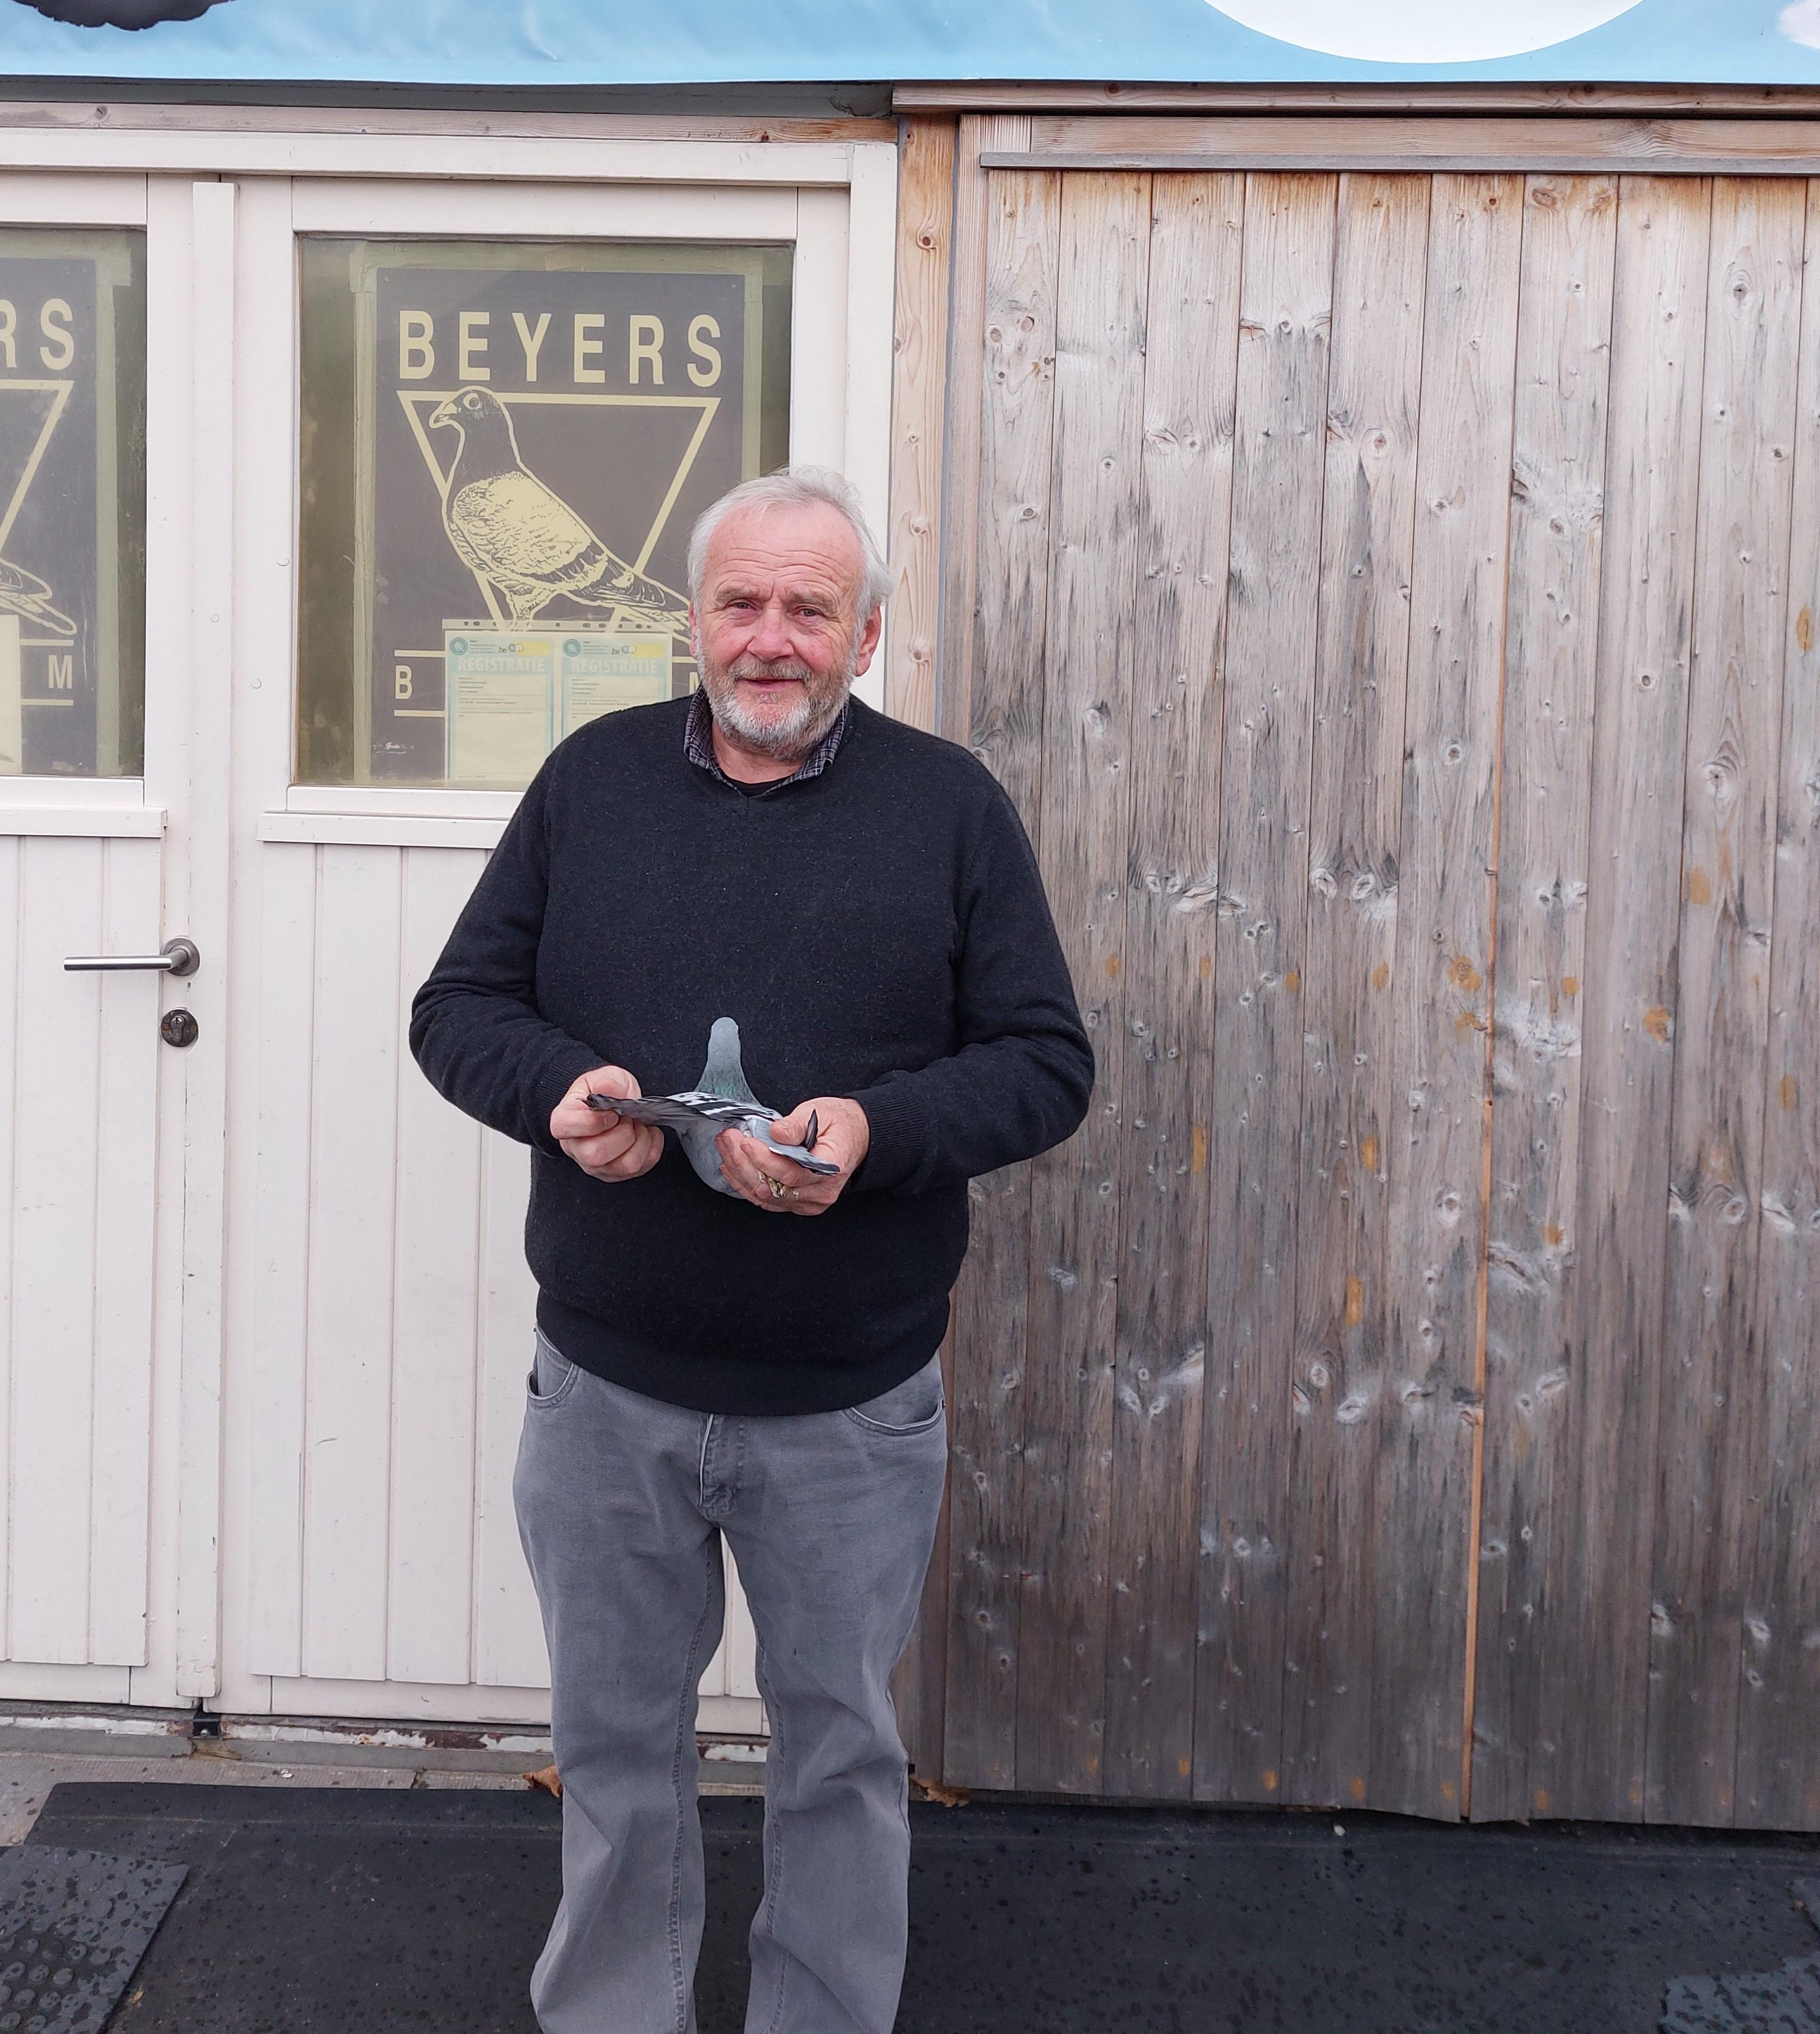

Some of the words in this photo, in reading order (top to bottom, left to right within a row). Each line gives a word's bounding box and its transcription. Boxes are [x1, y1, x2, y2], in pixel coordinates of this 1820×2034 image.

[399, 310, 722, 387] BEYERS
[48, 654, 73, 689] M
[395, 665, 413, 699] B
[458, 657, 545, 673] REGISTRATIE
[571, 659, 658, 674] REGISTRATIE
